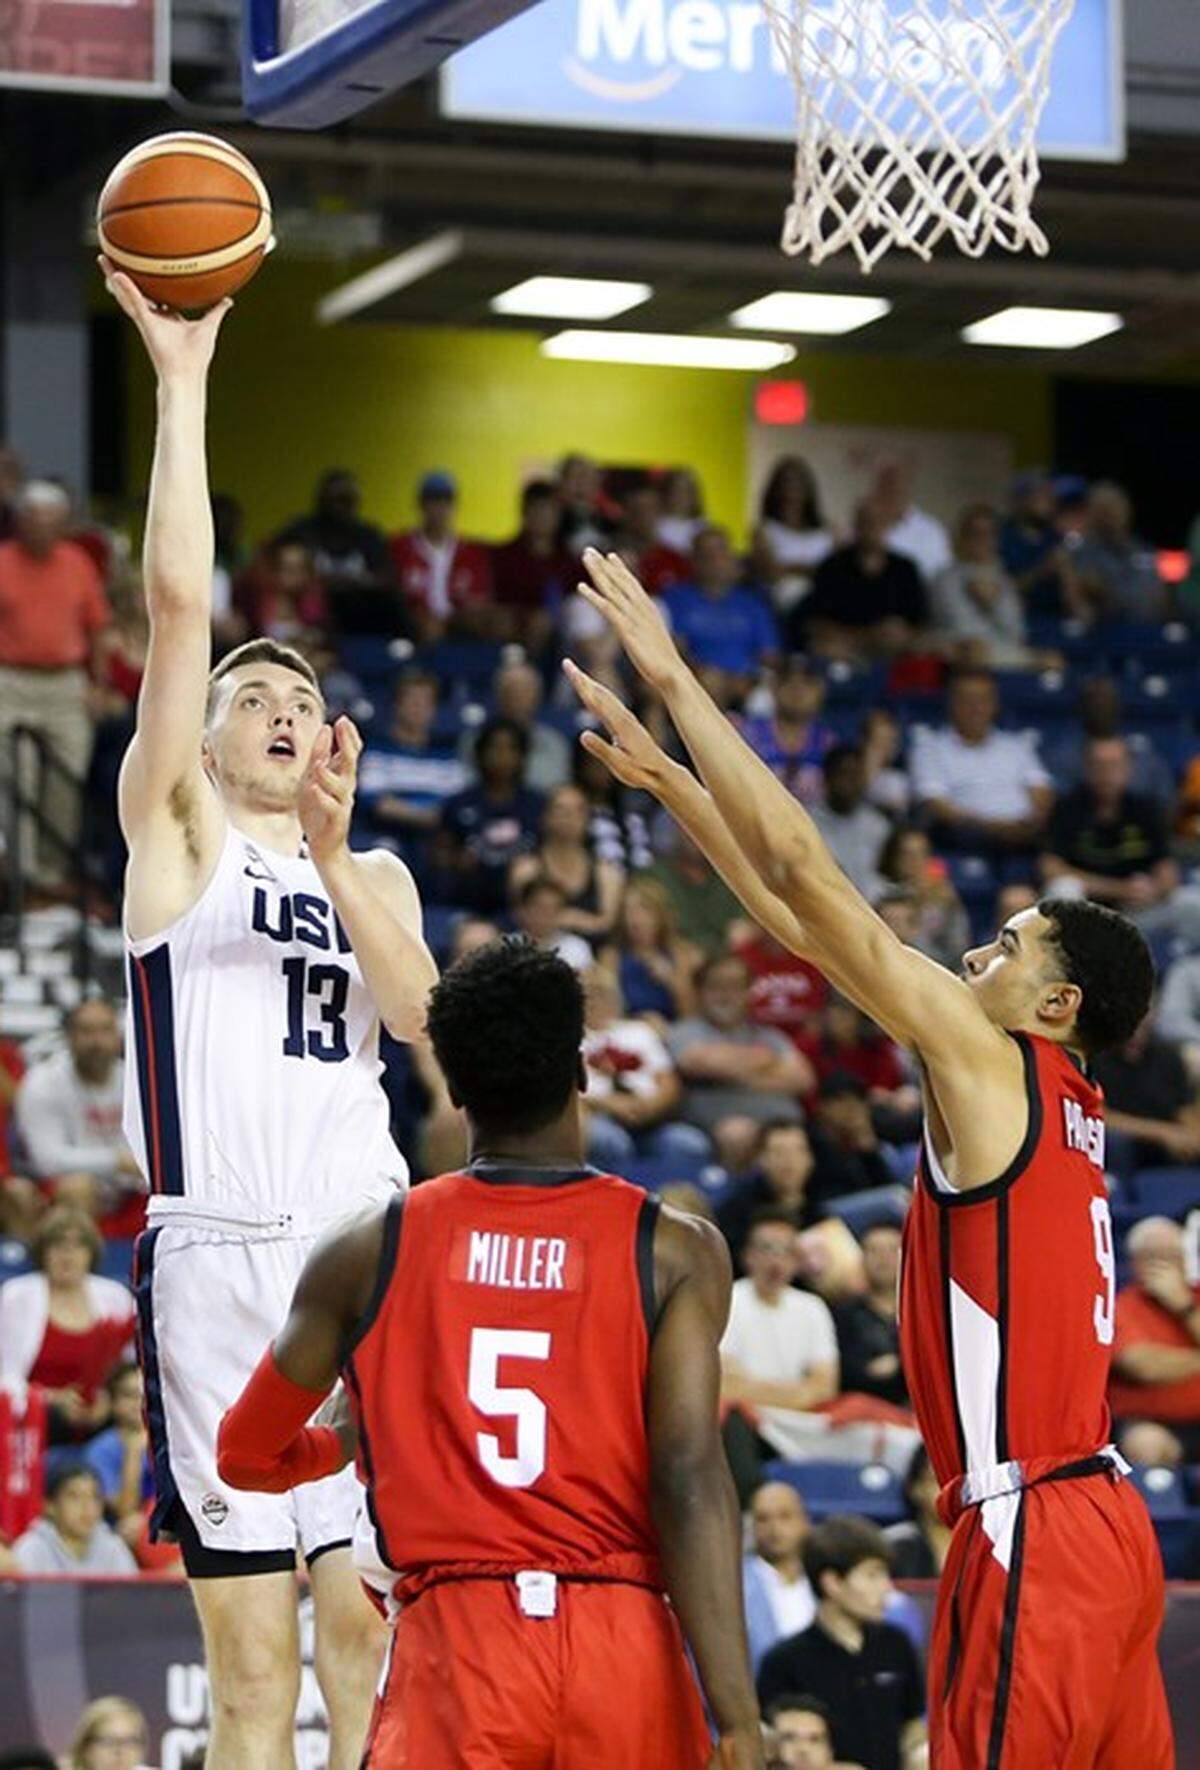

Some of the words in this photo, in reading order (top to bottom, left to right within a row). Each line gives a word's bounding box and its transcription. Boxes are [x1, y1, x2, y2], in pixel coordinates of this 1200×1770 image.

[282, 956, 350, 1063] 13
[467, 1231, 567, 1290] MILLER
[1090, 1196, 1115, 1345] 9
[467, 1327, 551, 1488] 5
